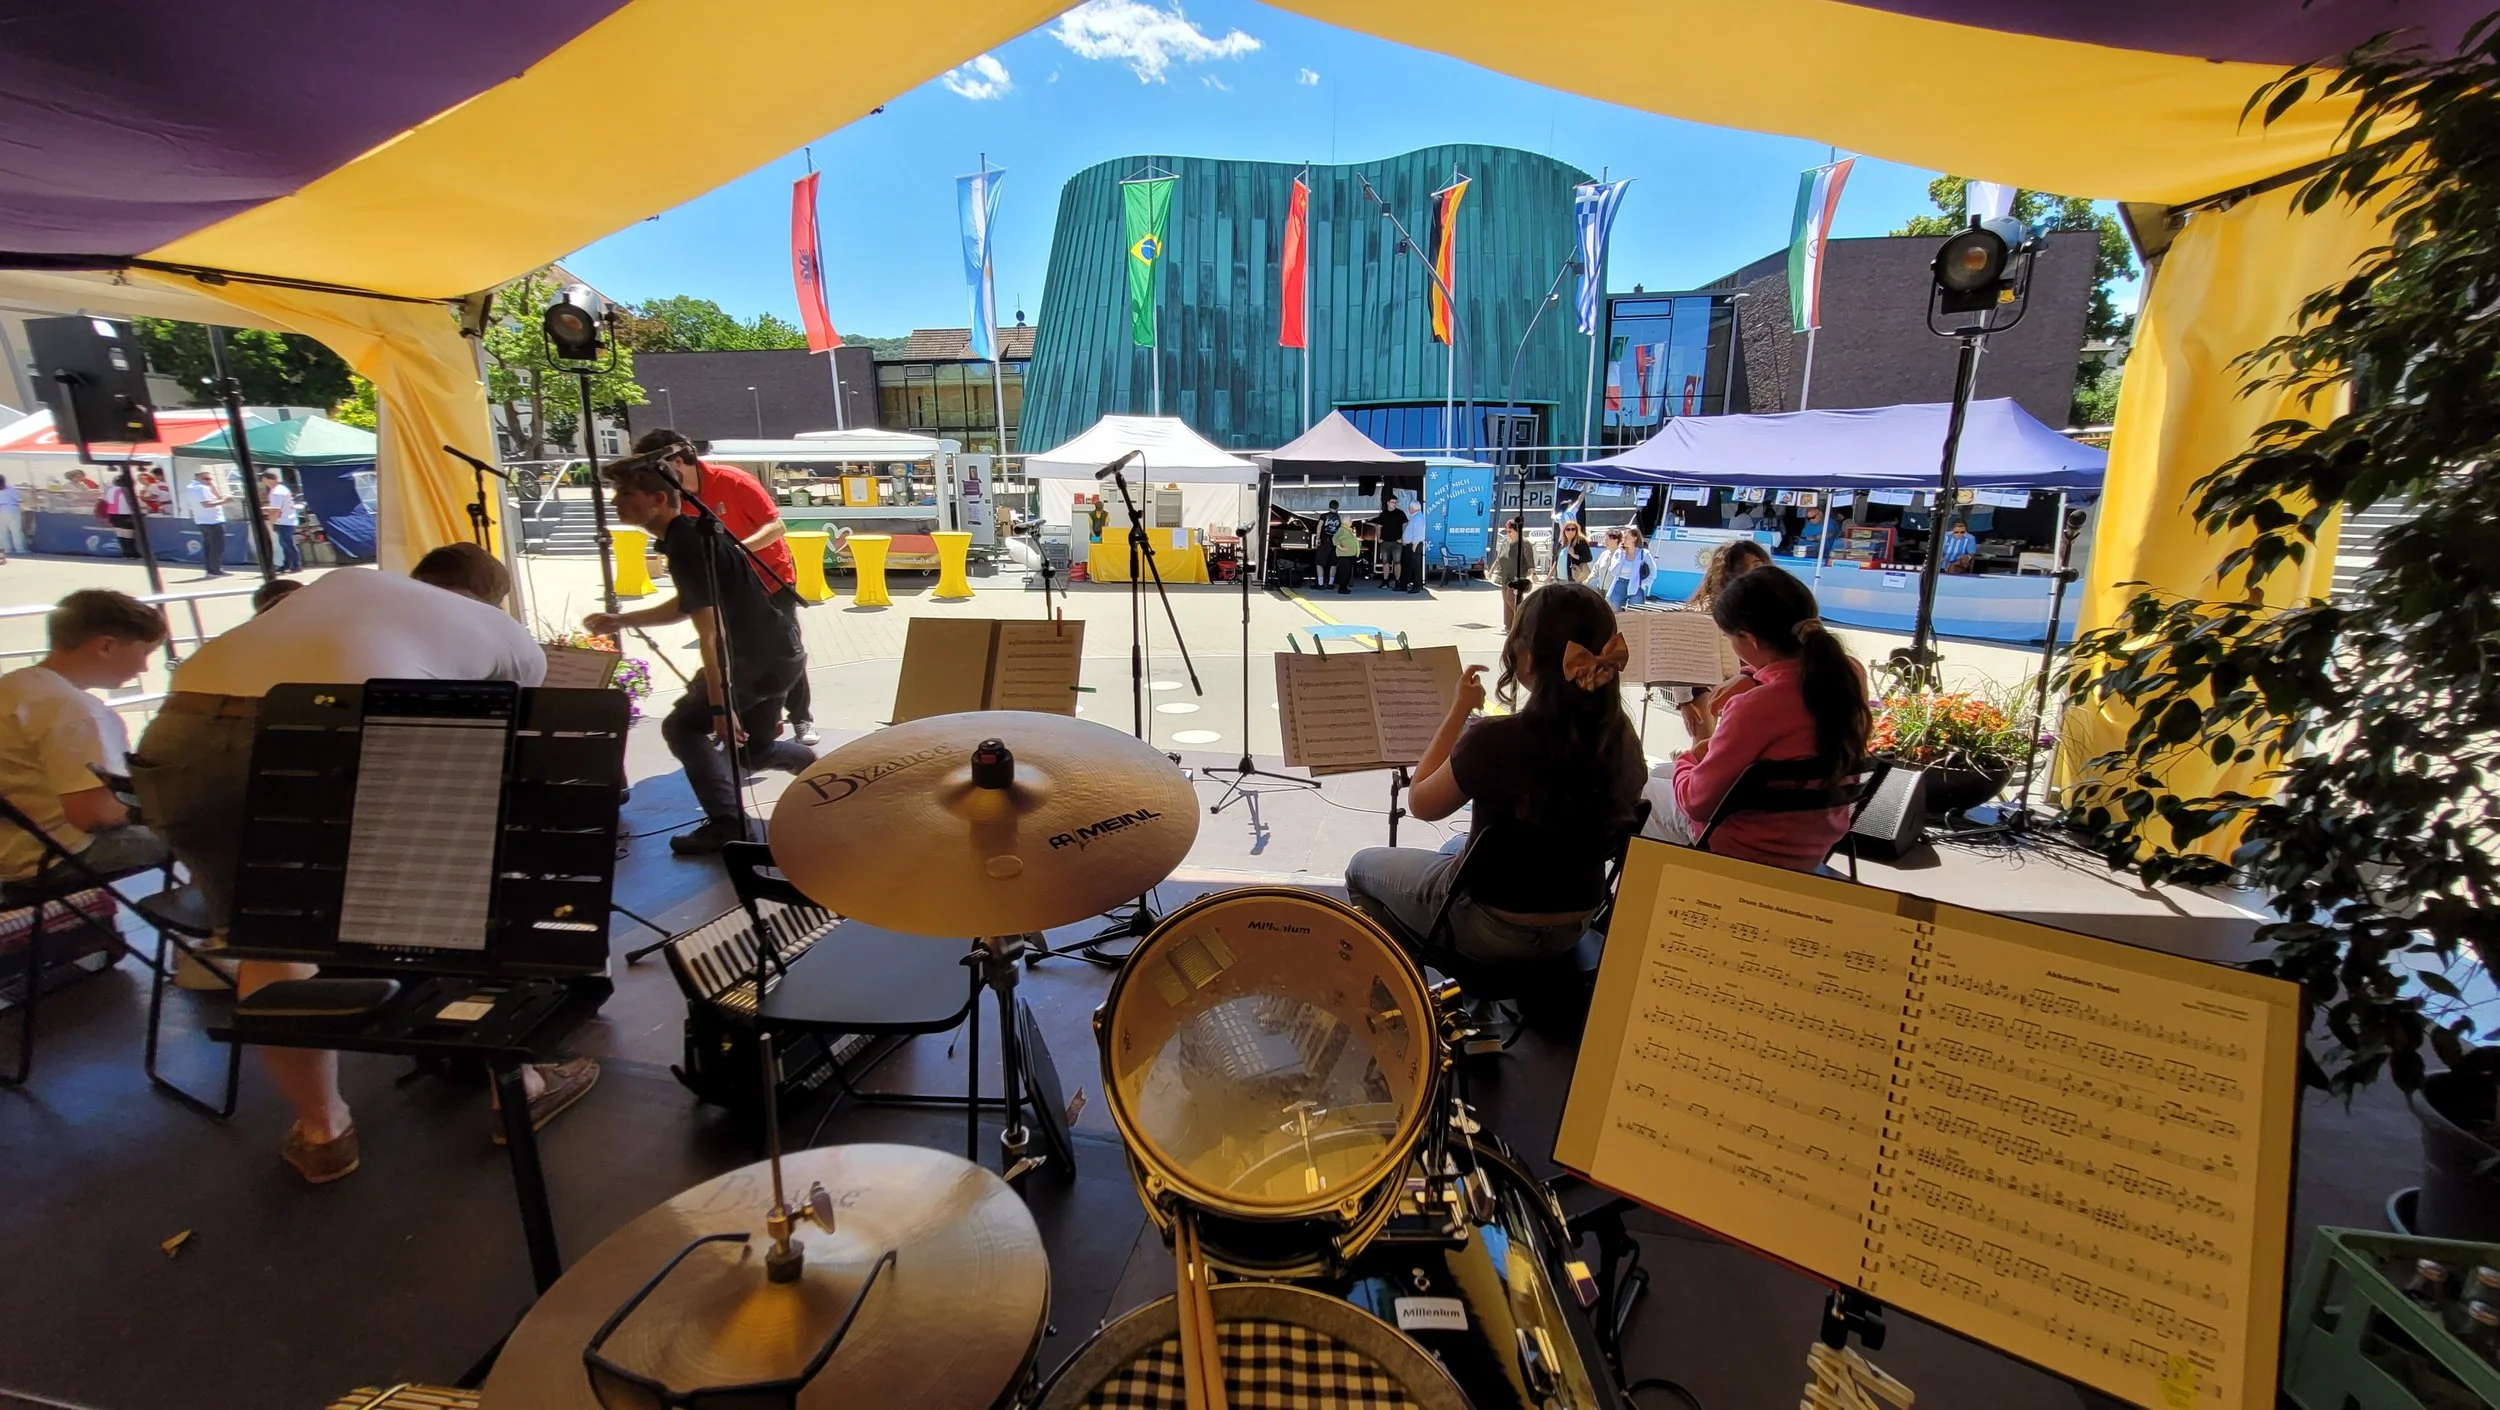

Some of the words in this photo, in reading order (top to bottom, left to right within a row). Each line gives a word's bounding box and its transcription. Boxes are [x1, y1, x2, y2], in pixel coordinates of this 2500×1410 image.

[1434, 484, 1449, 497] MIET
[1451, 478, 1470, 489] MICH
[1426, 496, 1446, 514] DANN
[1494, 491, 1553, 506] lm-Pla
[799, 745, 952, 807] Byzance
[1075, 808, 1163, 840] MEINL
[1738, 897, 1757, 907] Drum
[1758, 902, 1774, 911] Solo
[1403, 1307, 1460, 1318] Millenium
